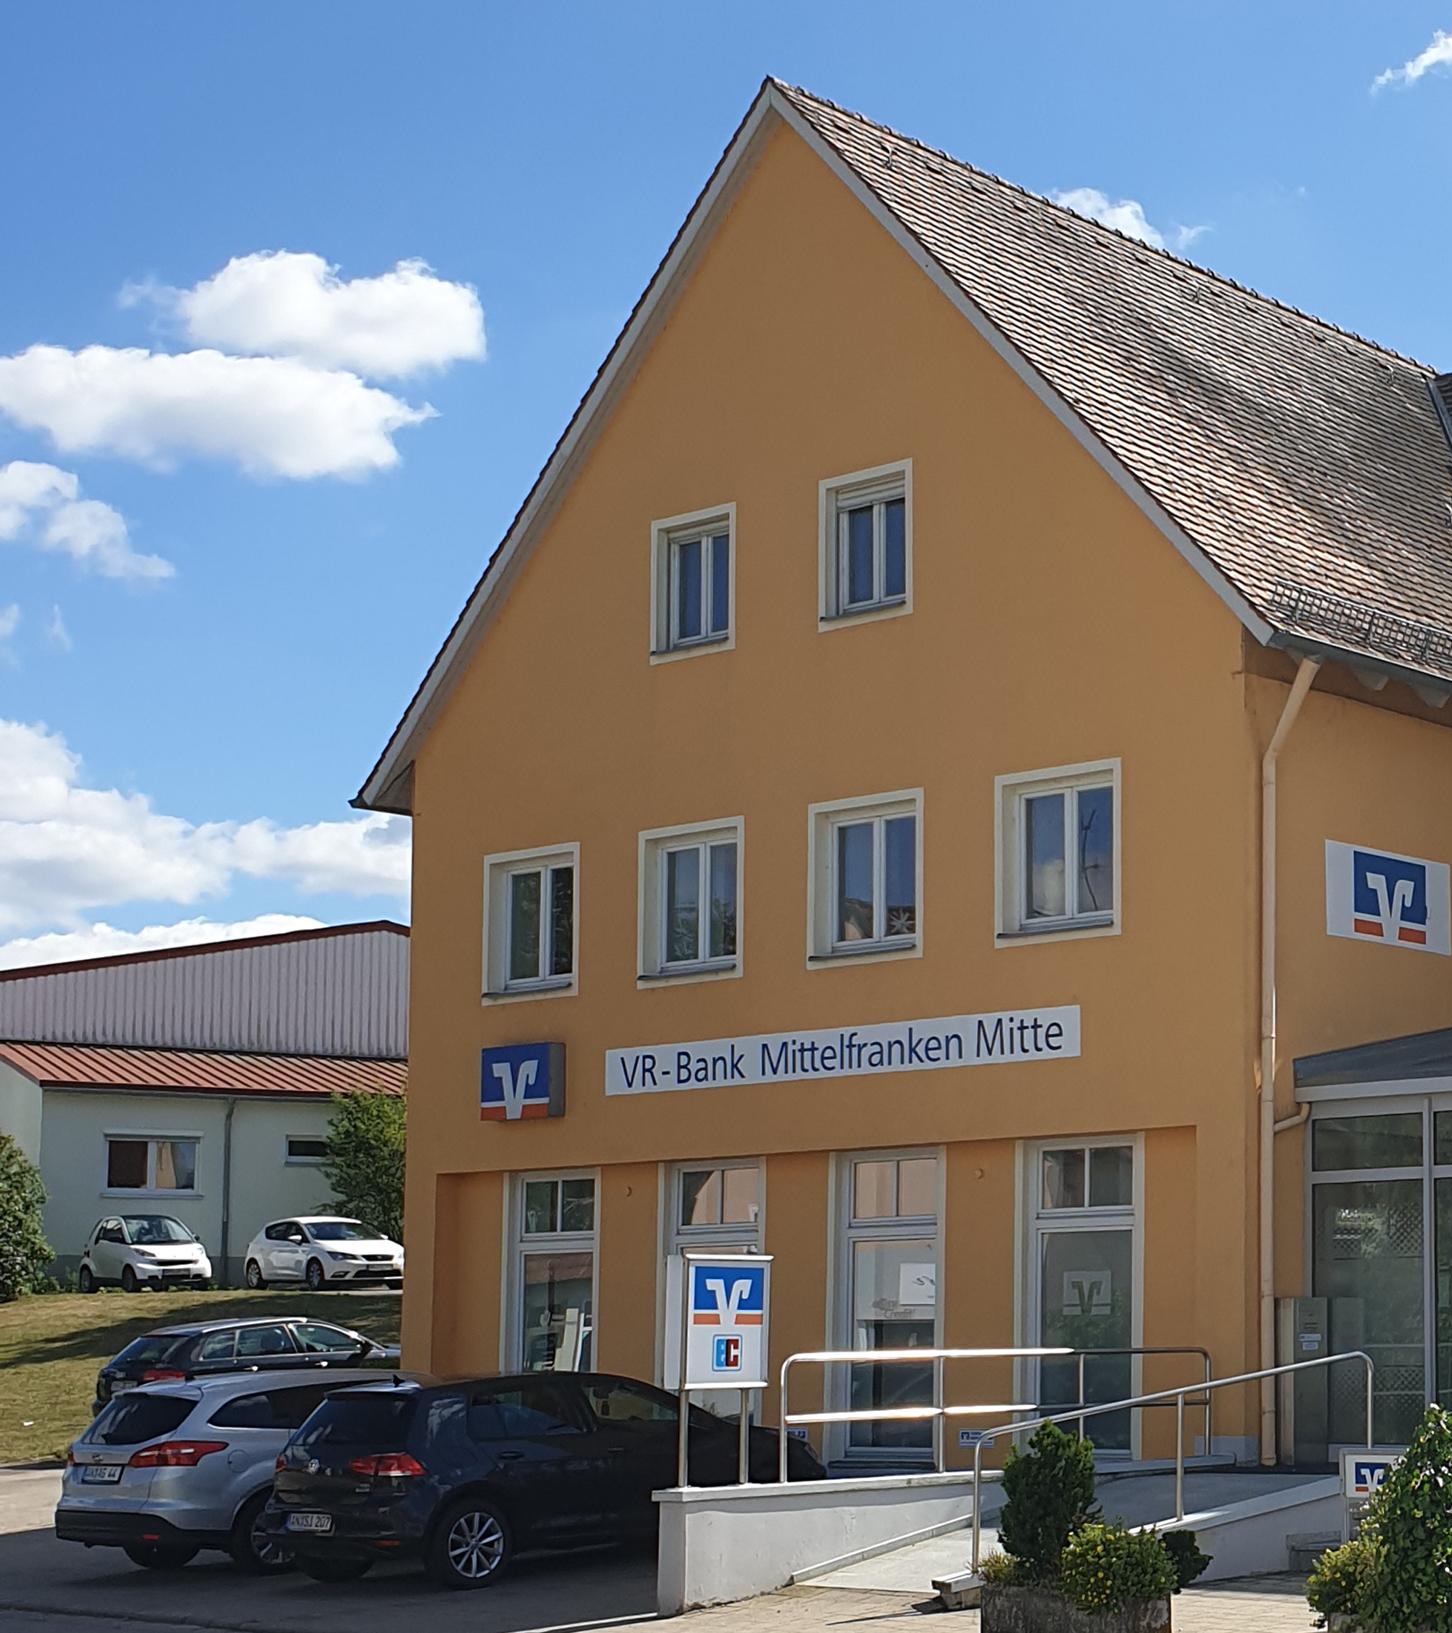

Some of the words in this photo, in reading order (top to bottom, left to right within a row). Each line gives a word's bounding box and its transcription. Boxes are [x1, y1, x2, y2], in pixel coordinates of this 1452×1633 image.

[620, 1044, 746, 1089] VR-Bank
[760, 1026, 963, 1077] Mittelfranken
[975, 1016, 1064, 1058] Mitte
